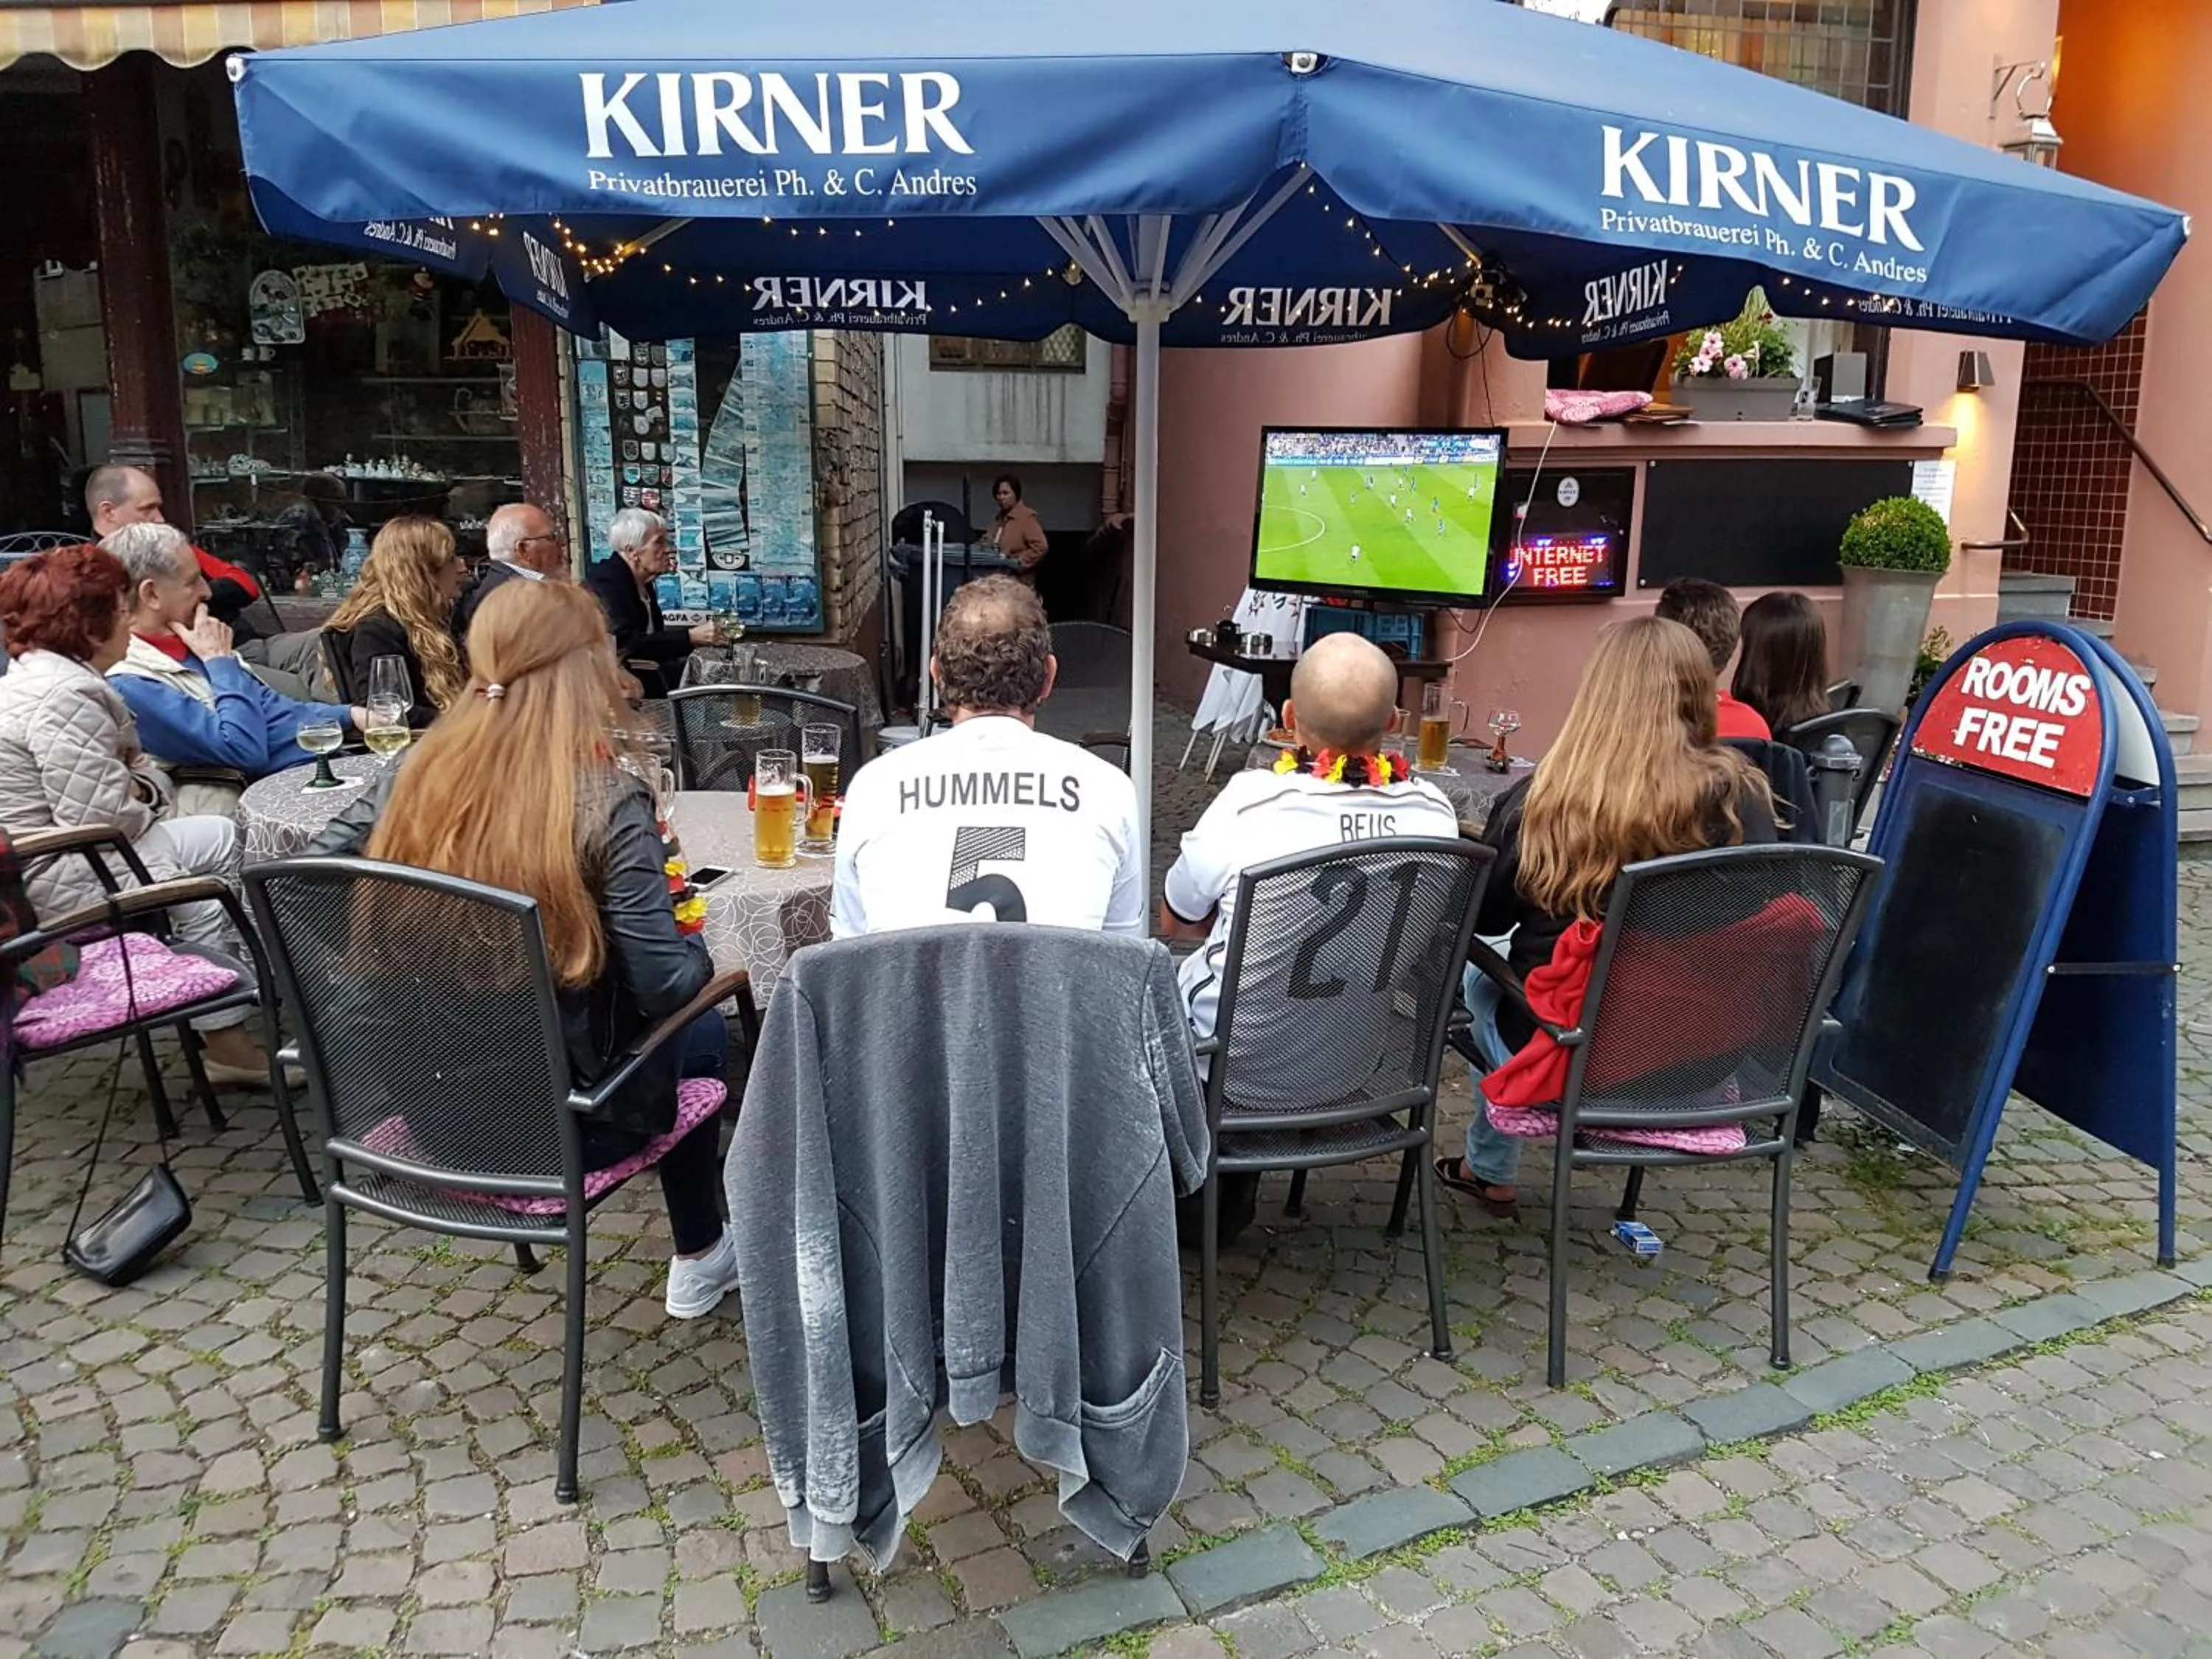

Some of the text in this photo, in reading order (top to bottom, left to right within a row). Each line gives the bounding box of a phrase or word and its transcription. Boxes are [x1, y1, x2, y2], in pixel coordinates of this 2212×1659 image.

[580, 72, 975, 158] KIRNER
[589, 168, 978, 198] Privatbrauerei Ph. & C. Andres
[1601, 125, 1926, 251] KIRNER
[1601, 209, 1927, 283] Privatbrauerei Ph. & C. Andres
[1514, 544, 1606, 566] INTERNET
[1533, 566, 1587, 587] FREE
[1961, 656, 2092, 717] ROOMS
[1953, 706, 2065, 769] FREE
[900, 772, 1080, 815] HUMMELS
[945, 826, 1028, 922] 5
[1287, 860, 1420, 998] 21
